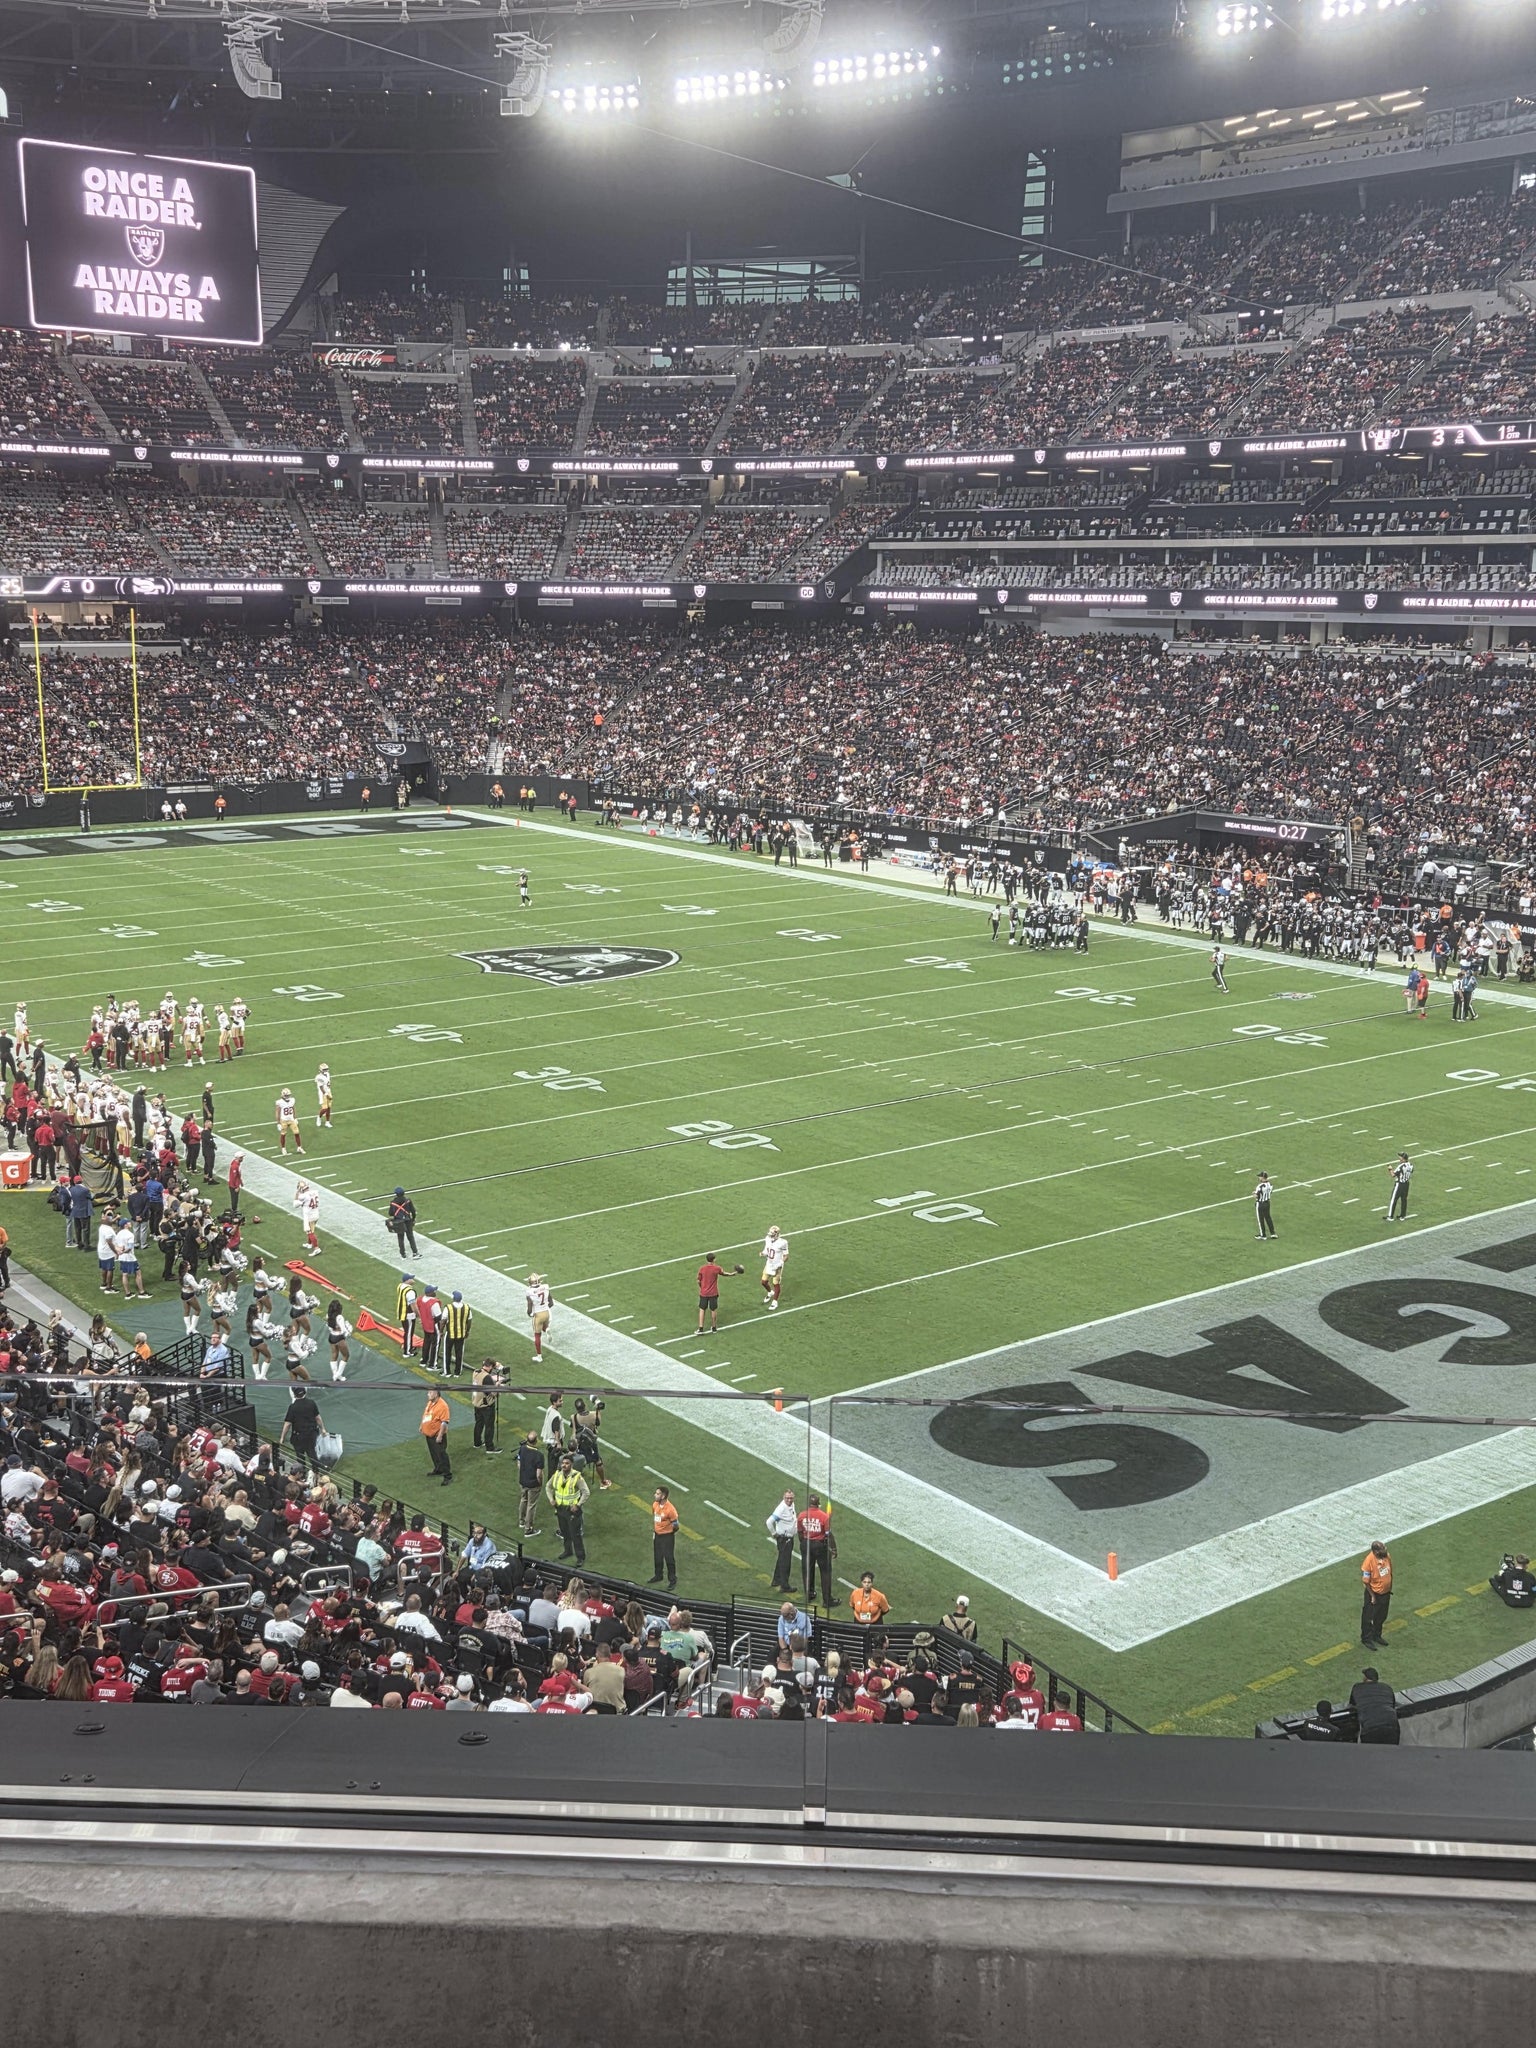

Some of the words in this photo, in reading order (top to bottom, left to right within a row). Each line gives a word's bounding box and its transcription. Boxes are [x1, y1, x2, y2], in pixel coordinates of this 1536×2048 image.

[84, 167, 164, 199] ONCE
[172, 178, 194, 203] A
[84, 191, 202, 230] RAIDER,
[74, 264, 191, 300] ALWAYS
[198, 276, 221, 303] A
[94, 290, 205, 323] RAIDER
[1432, 429, 1444, 446] 3
[1456, 429, 1464, 438] 3
[37, 445, 69, 454] ALWAYS
[79, 447, 110, 456] RAIDER
[1244, 443, 1266, 452] ONCE
[1307, 439, 1338, 449] ALWAYS
[171, 452, 193, 460] ONCE
[232, 454, 263, 462] ALWAYS
[273, 455, 303, 464] RAIDER
[905, 458, 923, 466] ONCE
[956, 456, 981, 464] ALWAYS
[989, 454, 1015, 463] RAIDER
[1066, 451, 1085, 460] ONCE
[1121, 448, 1150, 457] ALWAYS
[1158, 447, 1186, 456] RAIDER
[363, 459, 384, 467] ONCE
[425, 460, 456, 468] ALWAYS
[465, 461, 494, 469] RAIDER
[613, 462, 643, 470] ALWAYS
[793, 461, 820, 469] ALWAYS
[828, 460, 855, 468] RAIDER
[81, 580, 95, 593] 0
[214, 583, 245, 591] ALWAYS
[345, 584, 368, 592] ONCE
[409, 585, 441, 593] ALWAYS
[450, 585, 480, 593] RAIDER
[541, 586, 563, 594] ONCE
[643, 587, 671, 595] RAIDER
[920, 592, 945, 600] ALWAYS
[952, 592, 977, 600] RAIDER
[1119, 595, 1147, 603] RAIDER
[1204, 596, 1226, 604] ONCE
[1266, 597, 1296, 605] ALWAYS
[1307, 597, 1338, 605] RAIDER
[1403, 598, 1426, 606] ONCE
[1474, 599, 1509, 607] ALWAYS
[1224, 821, 1240, 829] BREAK
[1251, 824, 1276, 833] REMAINING
[1278, 824, 1308, 840] 0:27
[888, 834, 907, 842] RAIDERS
[27, 899, 84, 913] 20
[1328, 895, 1341, 905] LAS
[98, 923, 159, 938] 30
[776, 929, 842, 942] 50
[183, 951, 245, 967] 40
[904, 955, 971, 970] 40
[271, 984, 345, 1002] 50
[1054, 987, 1136, 1005] 30
[148, 1024, 159, 1034] 53
[189, 1021, 198, 1030] 83
[388, 1023, 464, 1043] 40
[1232, 1023, 1329, 1046] 20
[513, 1066, 603, 1092] 30
[1446, 1069, 1536, 1092] 10
[283, 1107, 294, 1116] 82
[665, 1120, 775, 1151] 20
[6, 1165, 20, 1179] G
[873, 1190, 985, 1223] 10
[537, 1291, 546, 1306] 7
[129, 1661, 150, 1678] LAWRENCE
[166, 1677, 181, 1686] KITTLE
[958, 1682, 976, 1690] PURDY
[856, 1705, 875, 1717] KITTLE
[1055, 1718, 1070, 1727] BOSA
[1307, 1722, 1331, 1735] SECURITY
